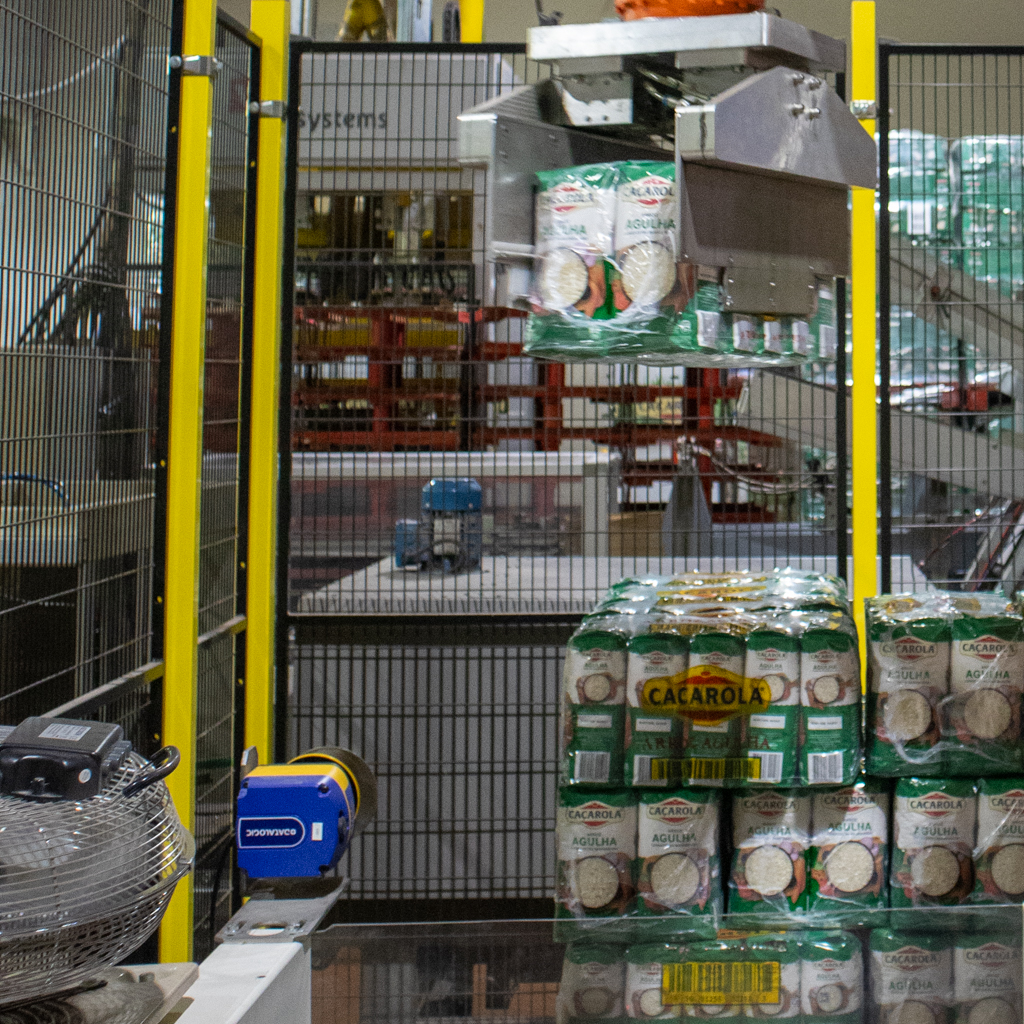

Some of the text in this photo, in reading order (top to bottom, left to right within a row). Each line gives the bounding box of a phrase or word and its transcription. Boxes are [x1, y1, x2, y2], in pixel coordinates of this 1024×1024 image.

[298, 111, 387, 132] systems
[702, 735, 770, 750] AGUHA
[748, 826, 791, 836] AGULHA
[829, 822, 872, 832] AGULHA
[572, 837, 617, 847] AGULHA
[652, 833, 697, 844] AGULHA
